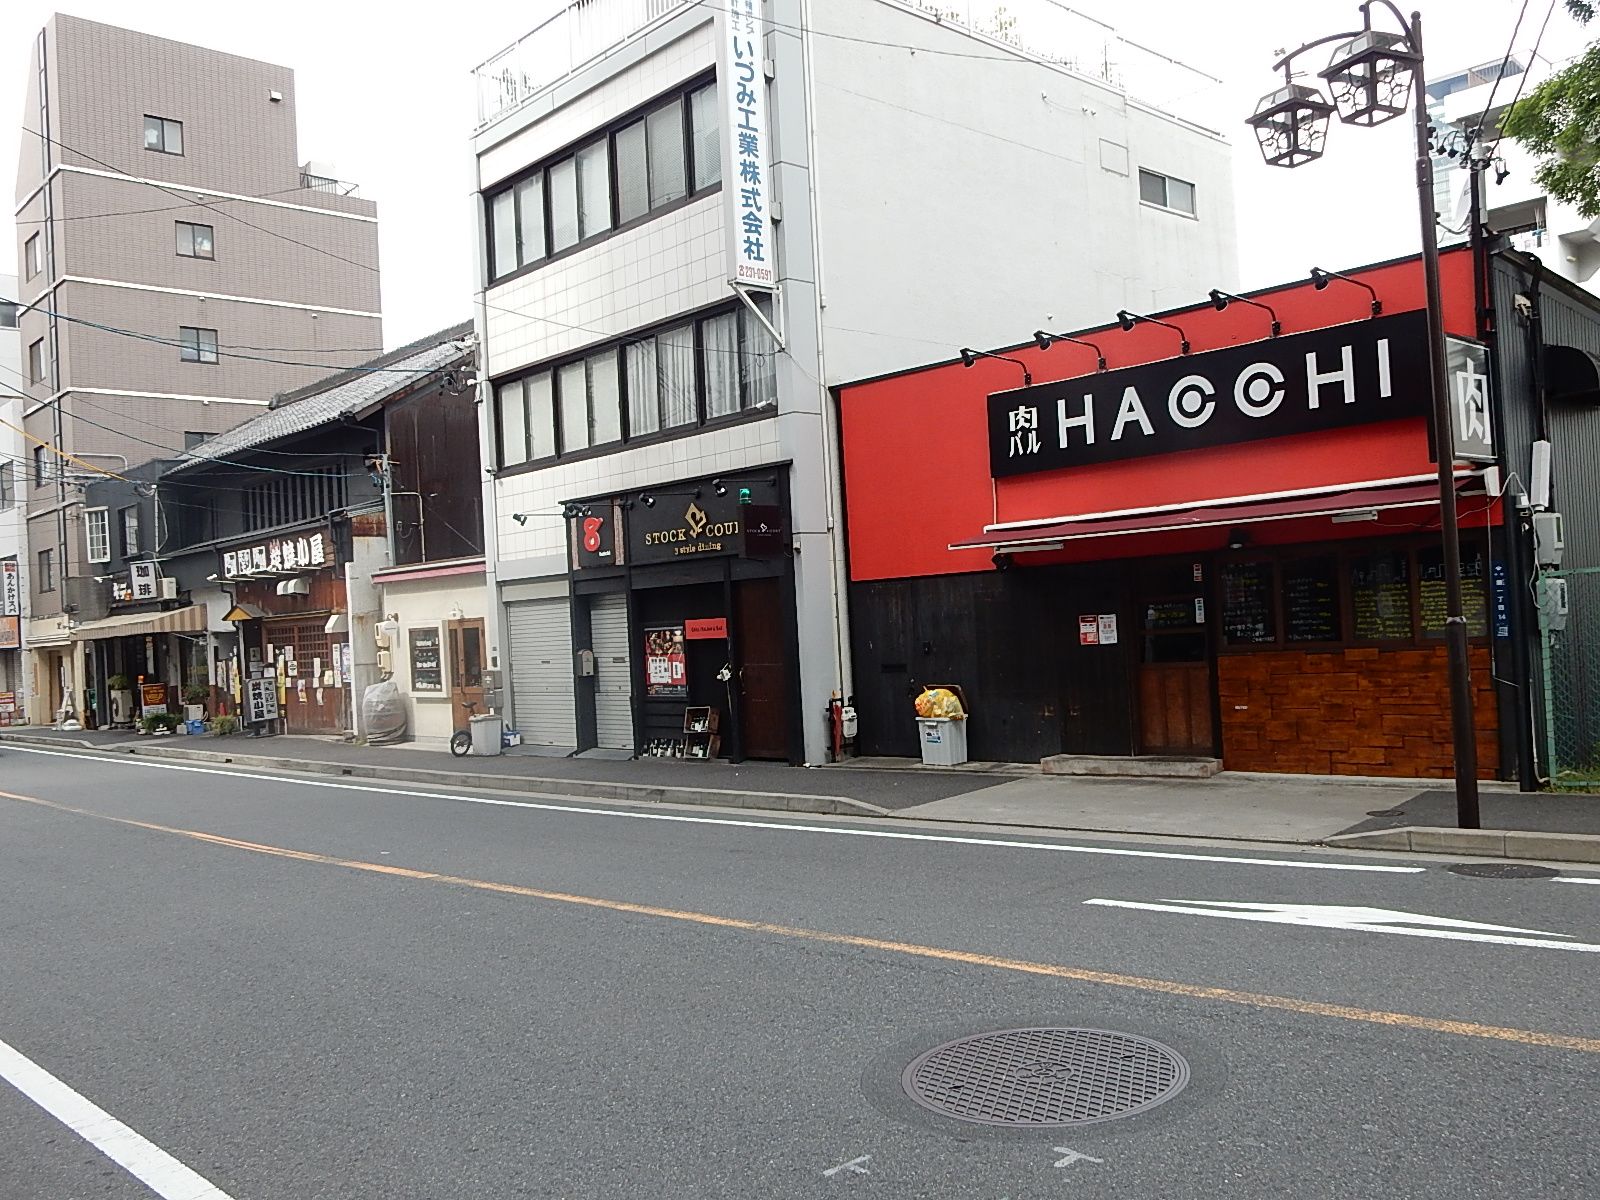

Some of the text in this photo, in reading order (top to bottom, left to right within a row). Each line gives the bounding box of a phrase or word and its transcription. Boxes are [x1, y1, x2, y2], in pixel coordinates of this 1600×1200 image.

[734, 35, 765, 261] いづみ工業株式会社
[1056, 338, 1392, 449] HACCHI
[1457, 357, 1493, 444] 肉
[1008, 405, 1039, 432] 肉
[1009, 431, 1041, 458] バル
[645, 528, 687, 545] STOCK
[680, 544, 696, 555] style
[697, 541, 721, 552] dining
[6, 573, 16, 613] あんかけスパ
[136, 565, 152, 595] 珈琲
